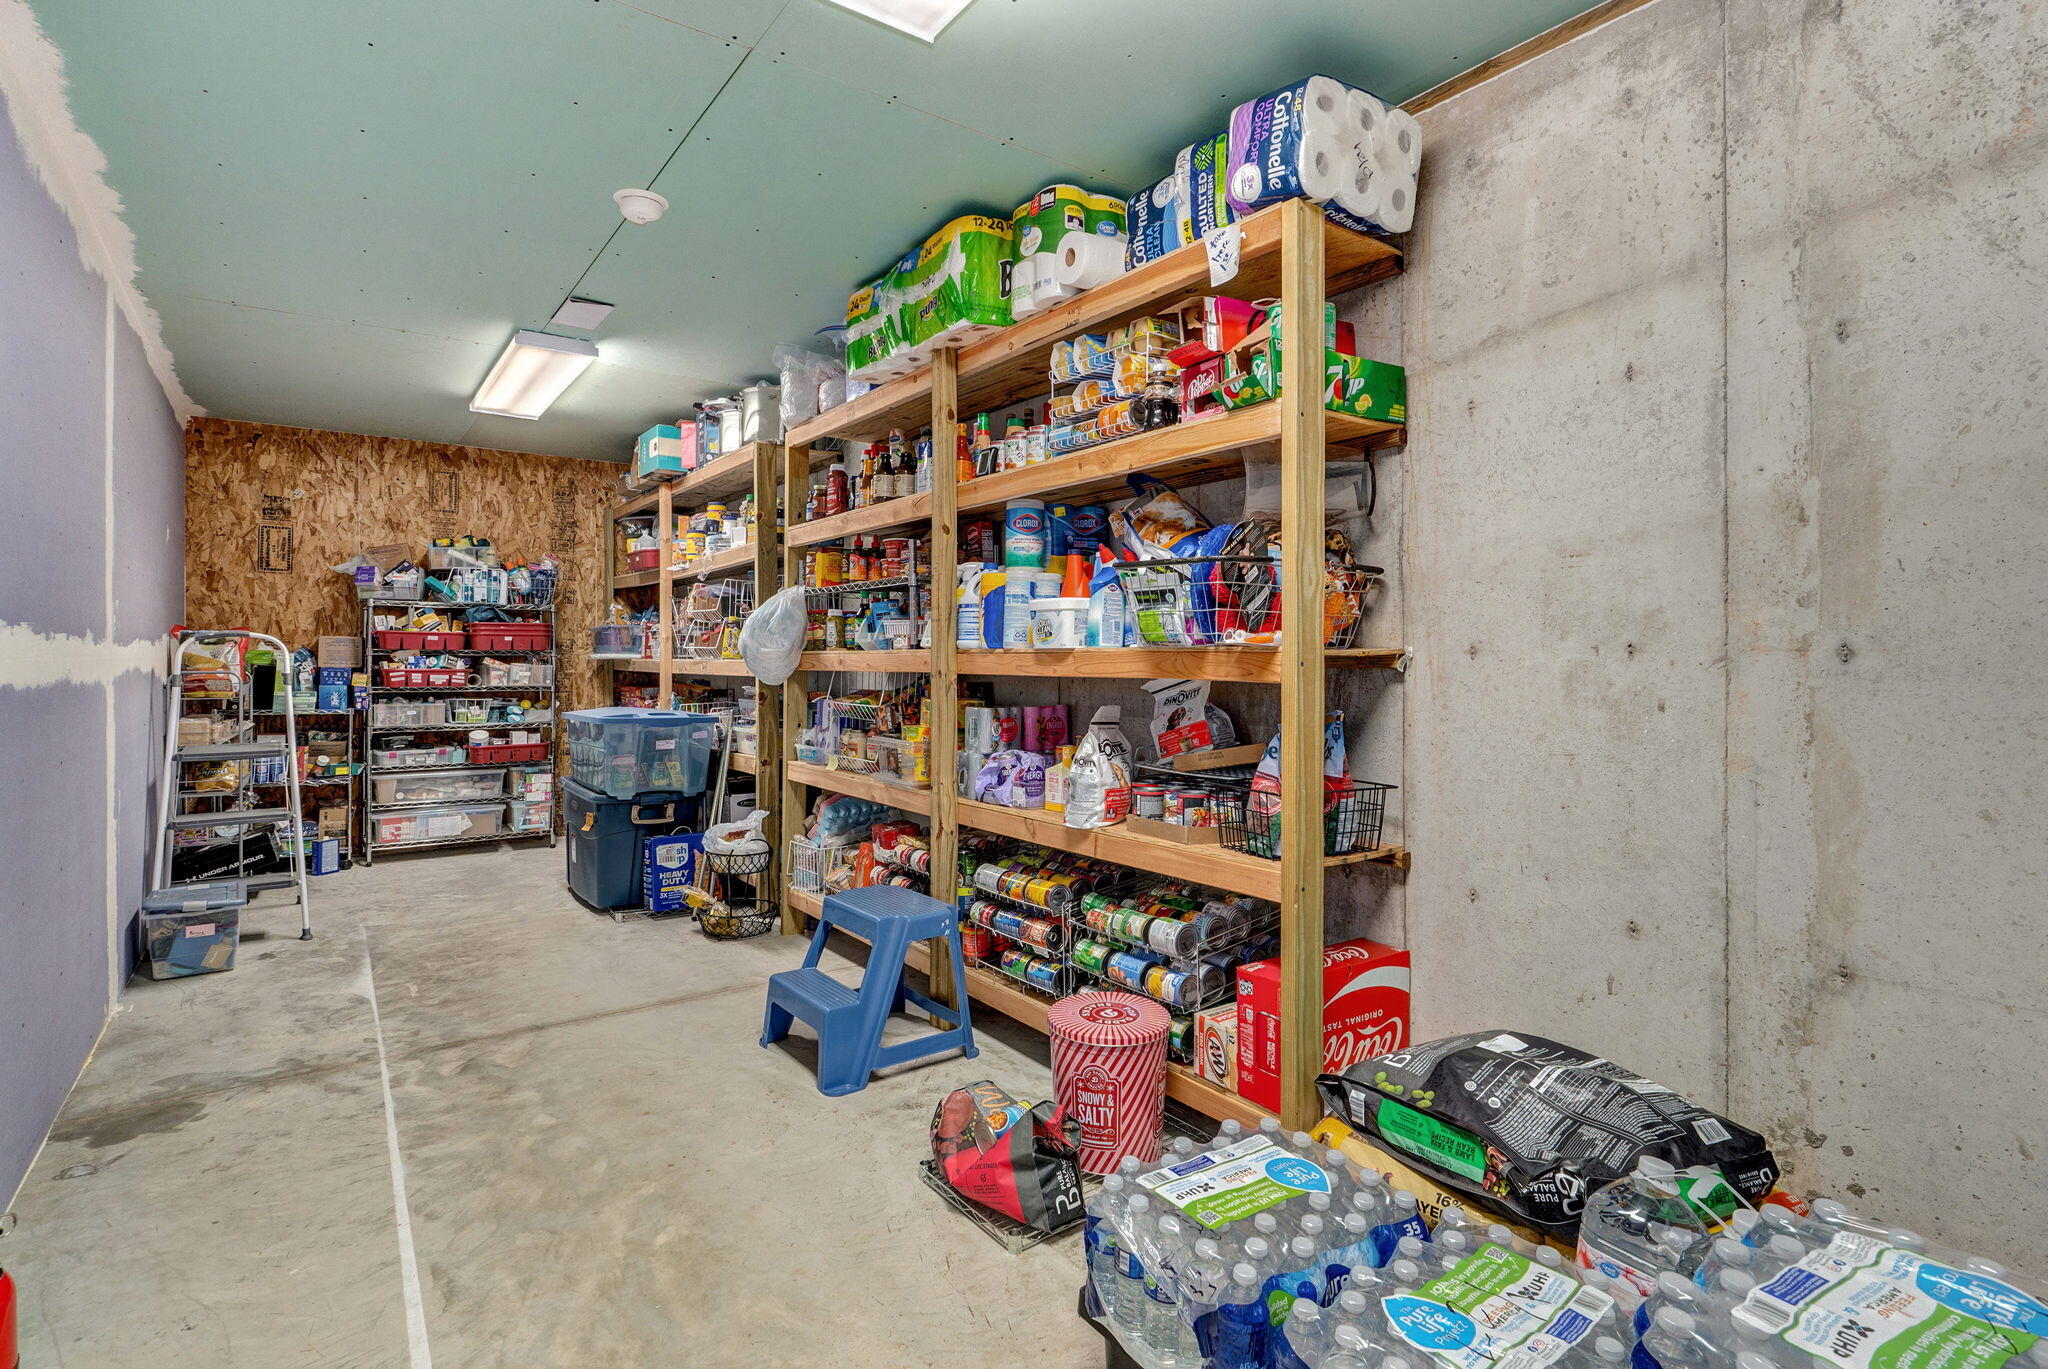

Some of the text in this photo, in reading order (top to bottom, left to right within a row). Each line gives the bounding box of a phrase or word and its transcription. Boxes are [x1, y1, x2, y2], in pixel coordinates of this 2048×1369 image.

[1260, 98, 1275, 142] ULTRA
[1267, 91, 1292, 191] Cottonelle
[1207, 174, 1215, 230] NORTHERN
[973, 217, 984, 227] 12
[987, 217, 1005, 233] 24
[1146, 226, 1155, 260] ULTRA
[1153, 221, 1161, 259] CLEAN
[1016, 519, 1039, 528] CLOROX
[1073, 519, 1096, 528] CLOROX
[1046, 721, 1062, 730] ENERGY
[1023, 770, 1043, 780] ENERGY
[198, 866, 228, 879] UNDER
[659, 869, 689, 880] HEAVY
[662, 876, 687, 886] DUTY
[1323, 1009, 1384, 1032] ORIGINAL TAST
[1077, 1090, 1115, 1107] SNOWY &
[1078, 1104, 1115, 1127] SALTY
[1430, 1138, 1446, 1151] FAVA
[1431, 1131, 1476, 1153] BEAN RECIPE
[1447, 1145, 1454, 1154] &
[1454, 1148, 1475, 1162] LAMB
[1222, 1167, 1252, 1180] AMERICA
[1272, 1160, 1298, 1172] Project
[1284, 1166, 1308, 1178] Life
[1056, 1171, 1067, 1190] PURE
[1291, 1172, 1320, 1185] Pure
[1533, 1193, 1559, 1203] PURE
[1403, 1221, 1421, 1237] 35
[1400, 1305, 1435, 1327] Pure
[1417, 1313, 1445, 1334] Life
[1434, 1320, 1469, 1345] Project
[1830, 1330, 1861, 1358] UHP
